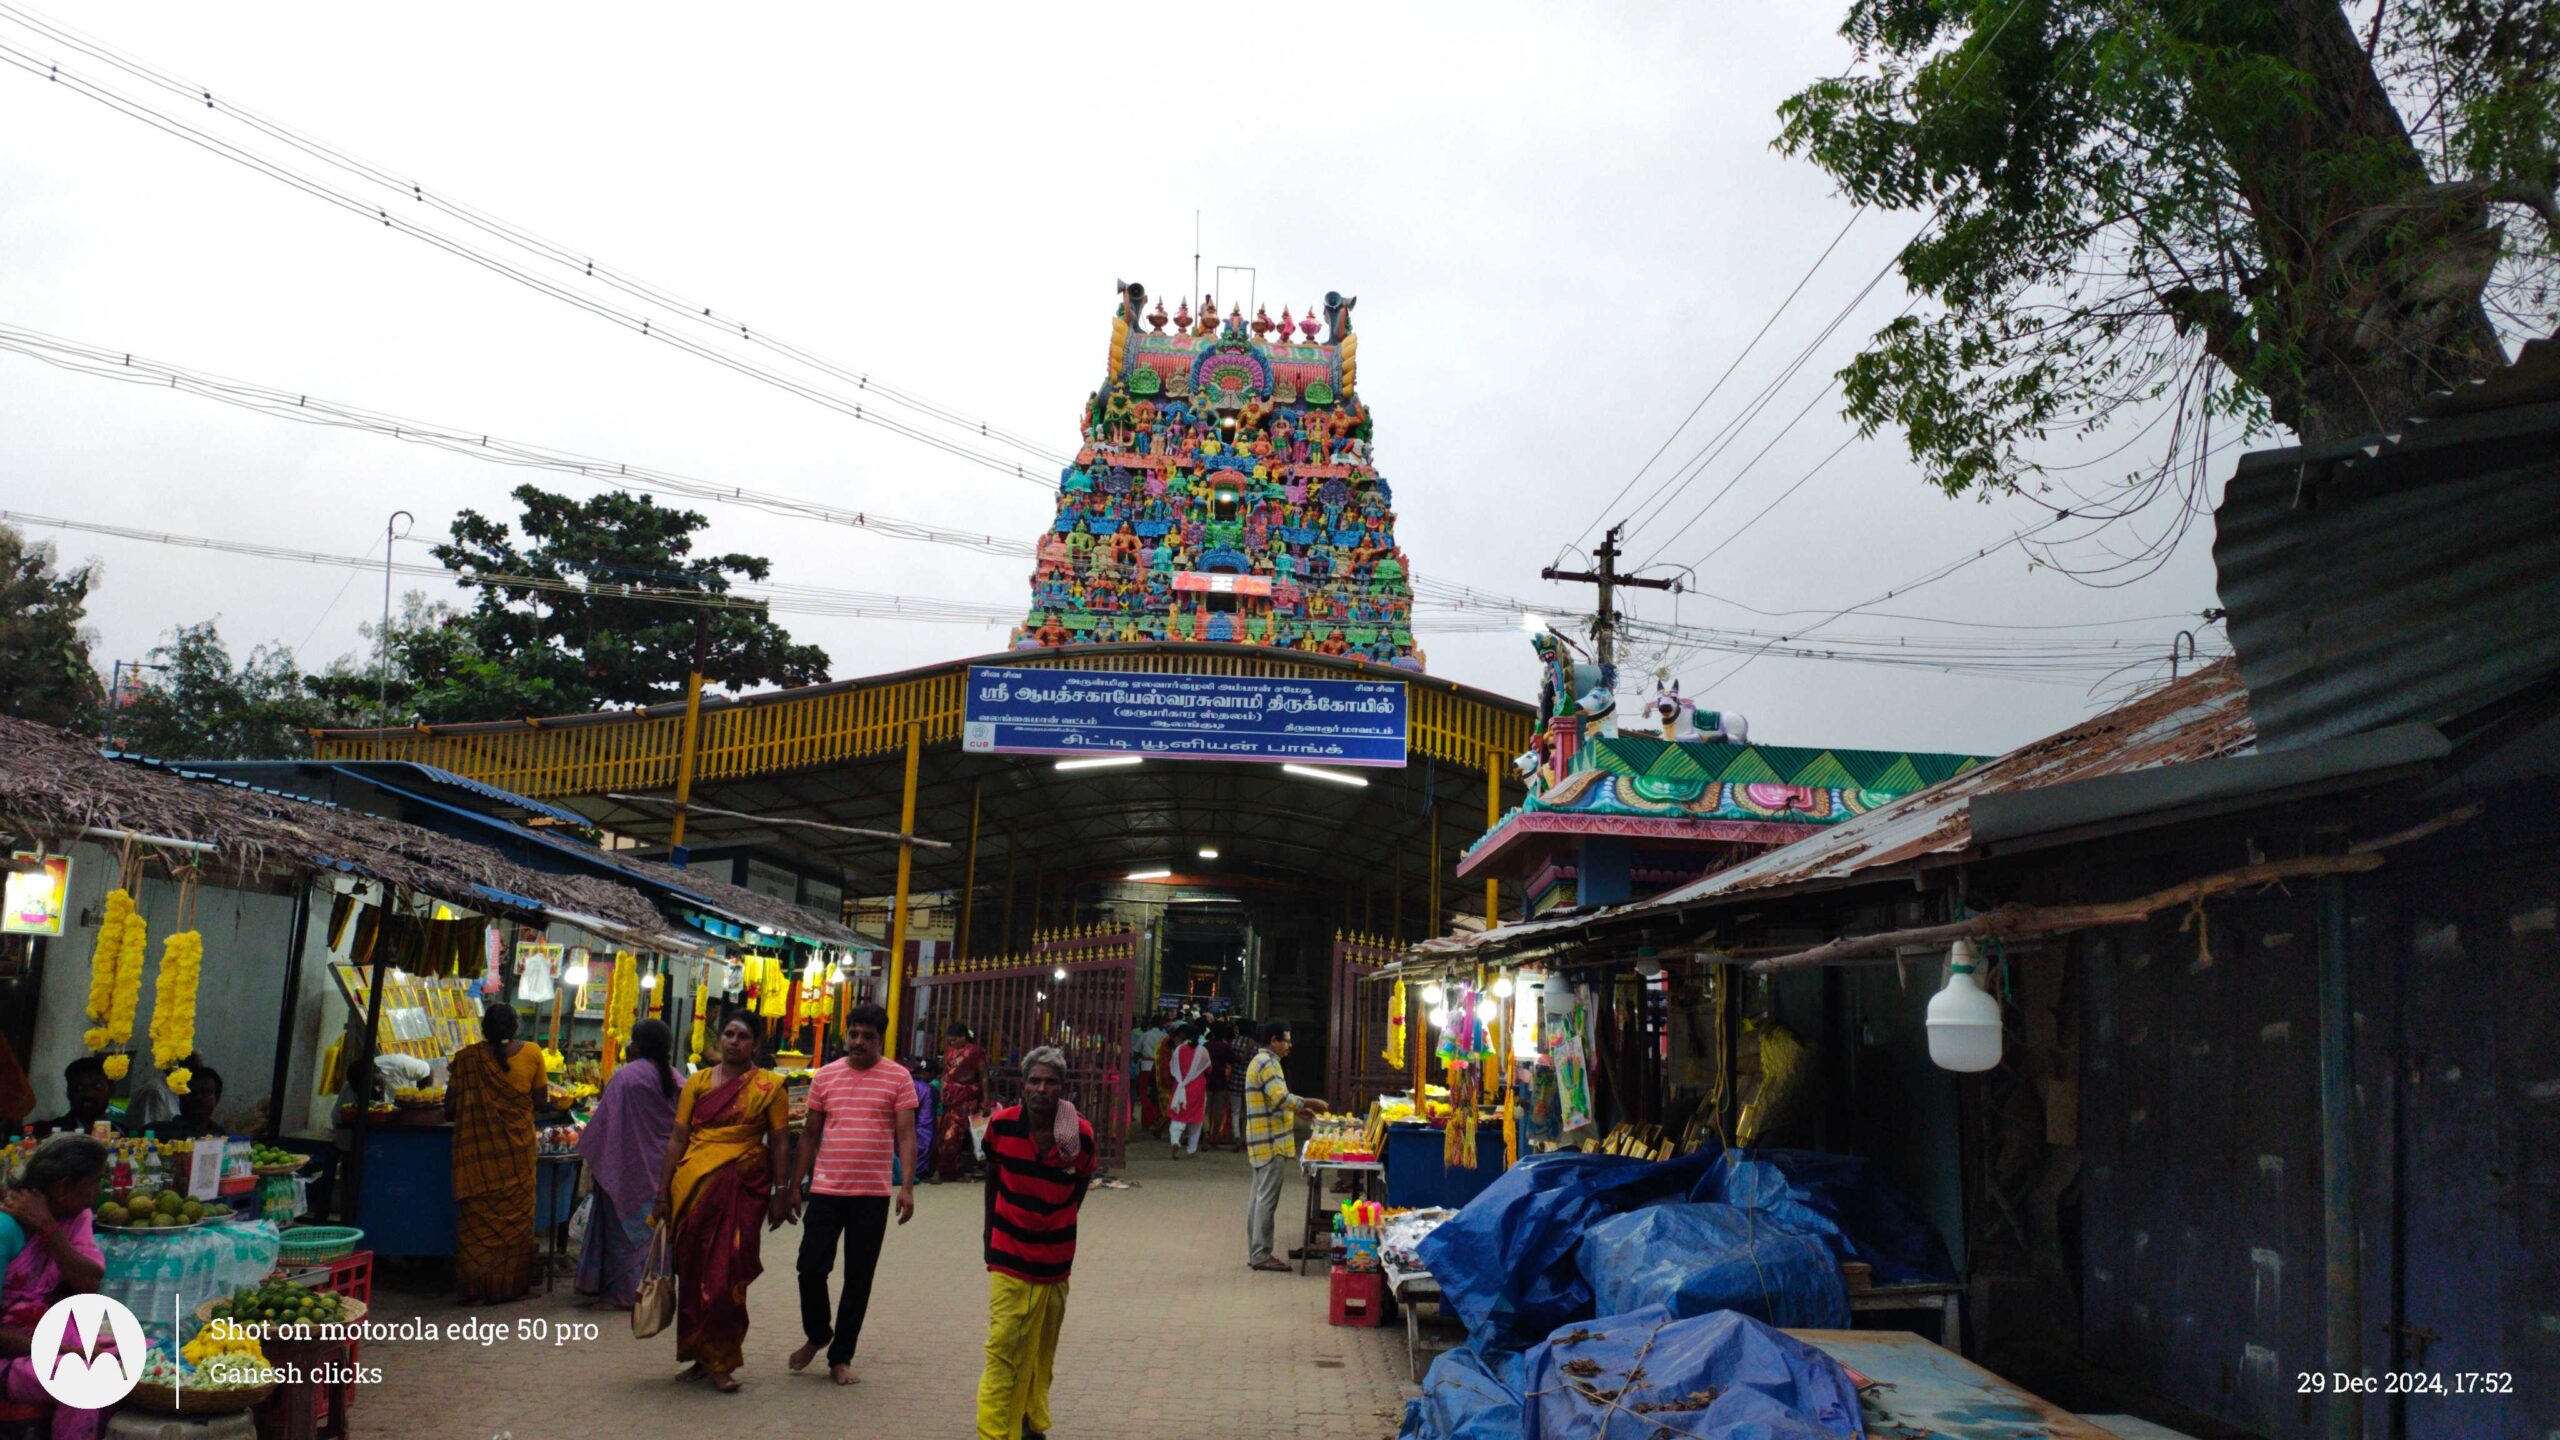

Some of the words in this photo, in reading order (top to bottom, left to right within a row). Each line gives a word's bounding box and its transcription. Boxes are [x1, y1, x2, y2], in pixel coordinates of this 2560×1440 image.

[1015, 685, 1263, 709] ஆபத்சகாயேஸ்வரசுவாமி
[1266, 694, 1395, 713] திருக்கோயில்
[1062, 734, 1132, 749] சிட்டி
[1141, 738, 1259, 751] யூனியன்
[1267, 743, 1344, 754] பாங்க்
